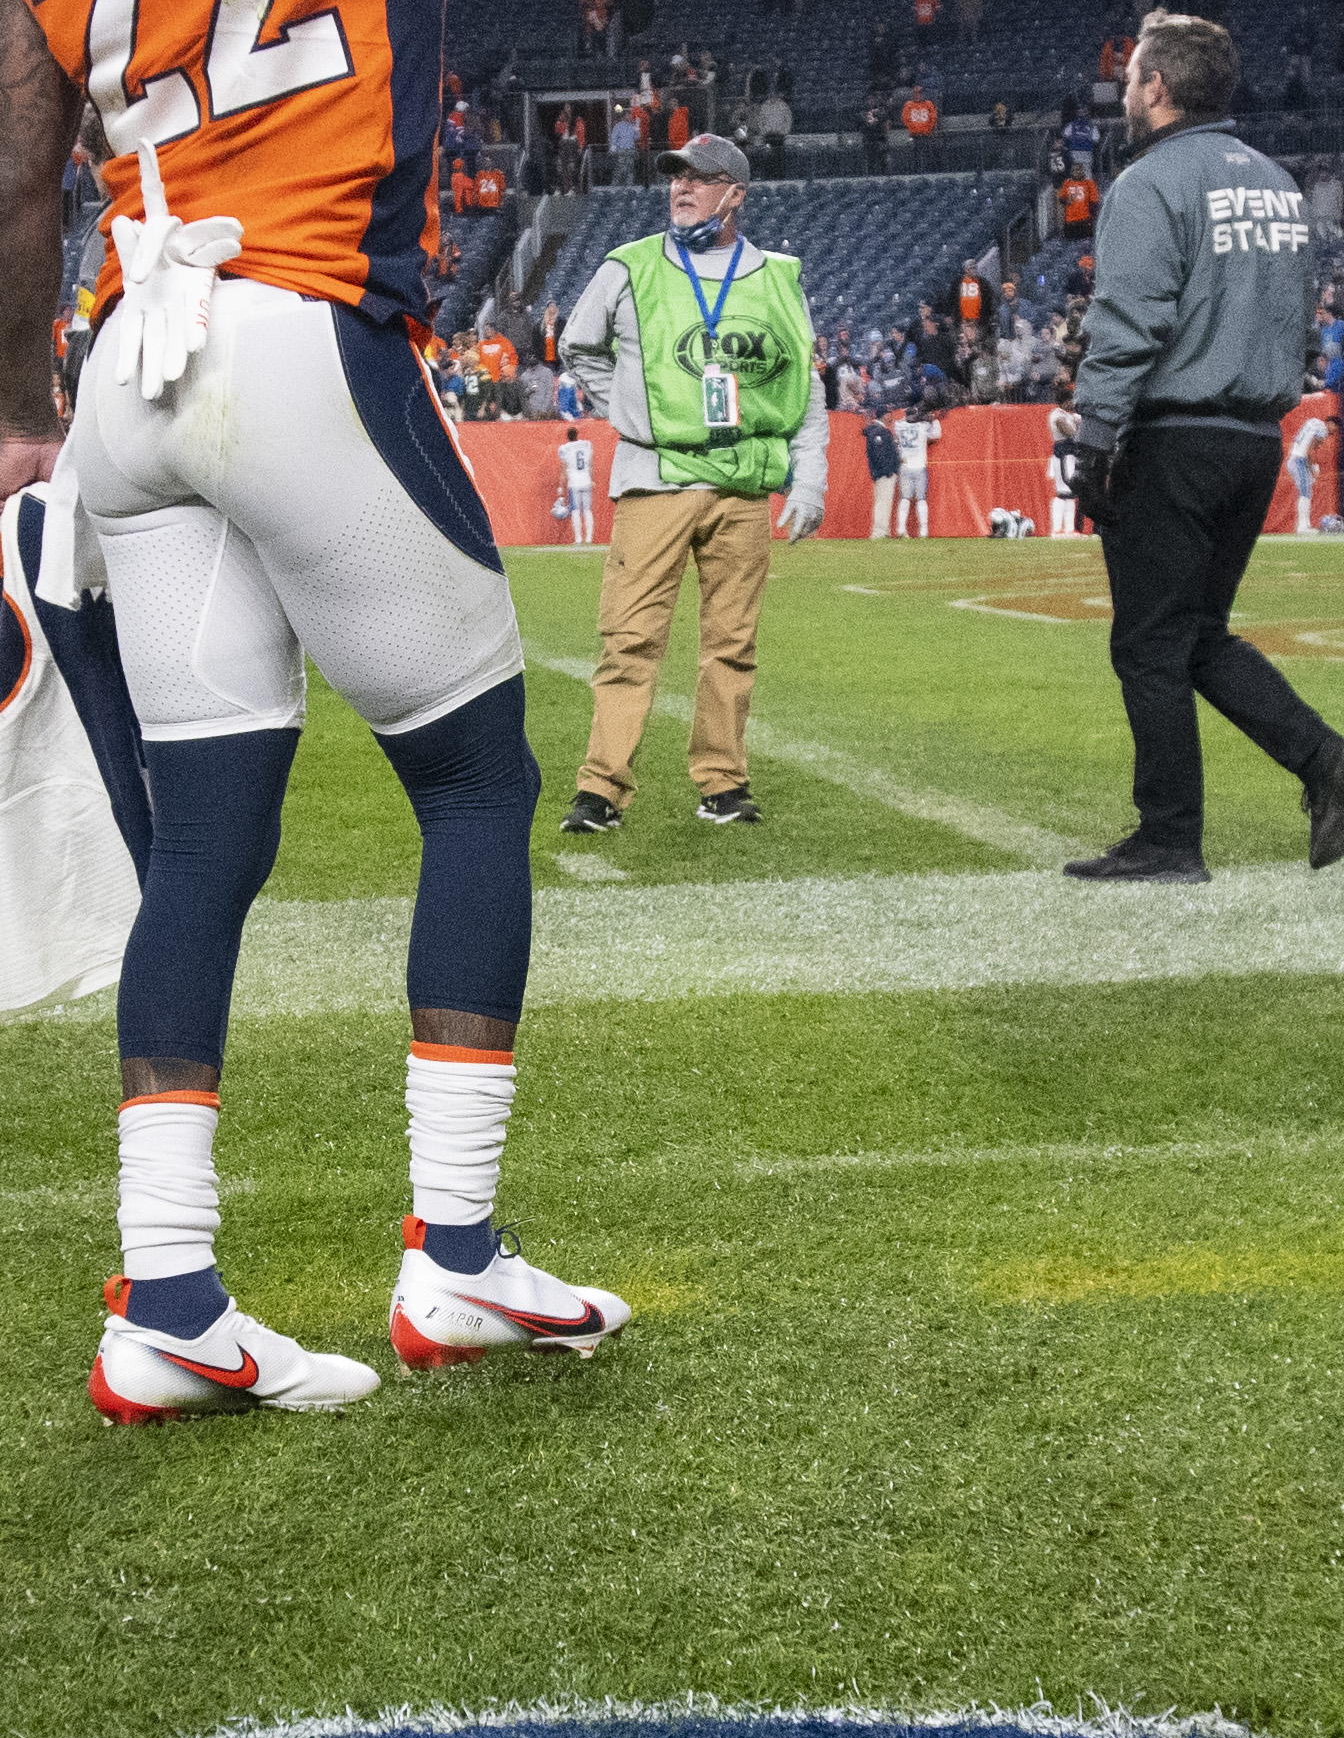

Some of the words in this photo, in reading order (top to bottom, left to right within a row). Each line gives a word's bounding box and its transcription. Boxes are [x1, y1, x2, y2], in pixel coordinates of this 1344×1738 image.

[1207, 187, 1303, 220] EVENT
[1212, 220, 1309, 254] STAFF
[960, 282, 981, 298] 18
[576, 450, 586, 471] 6
